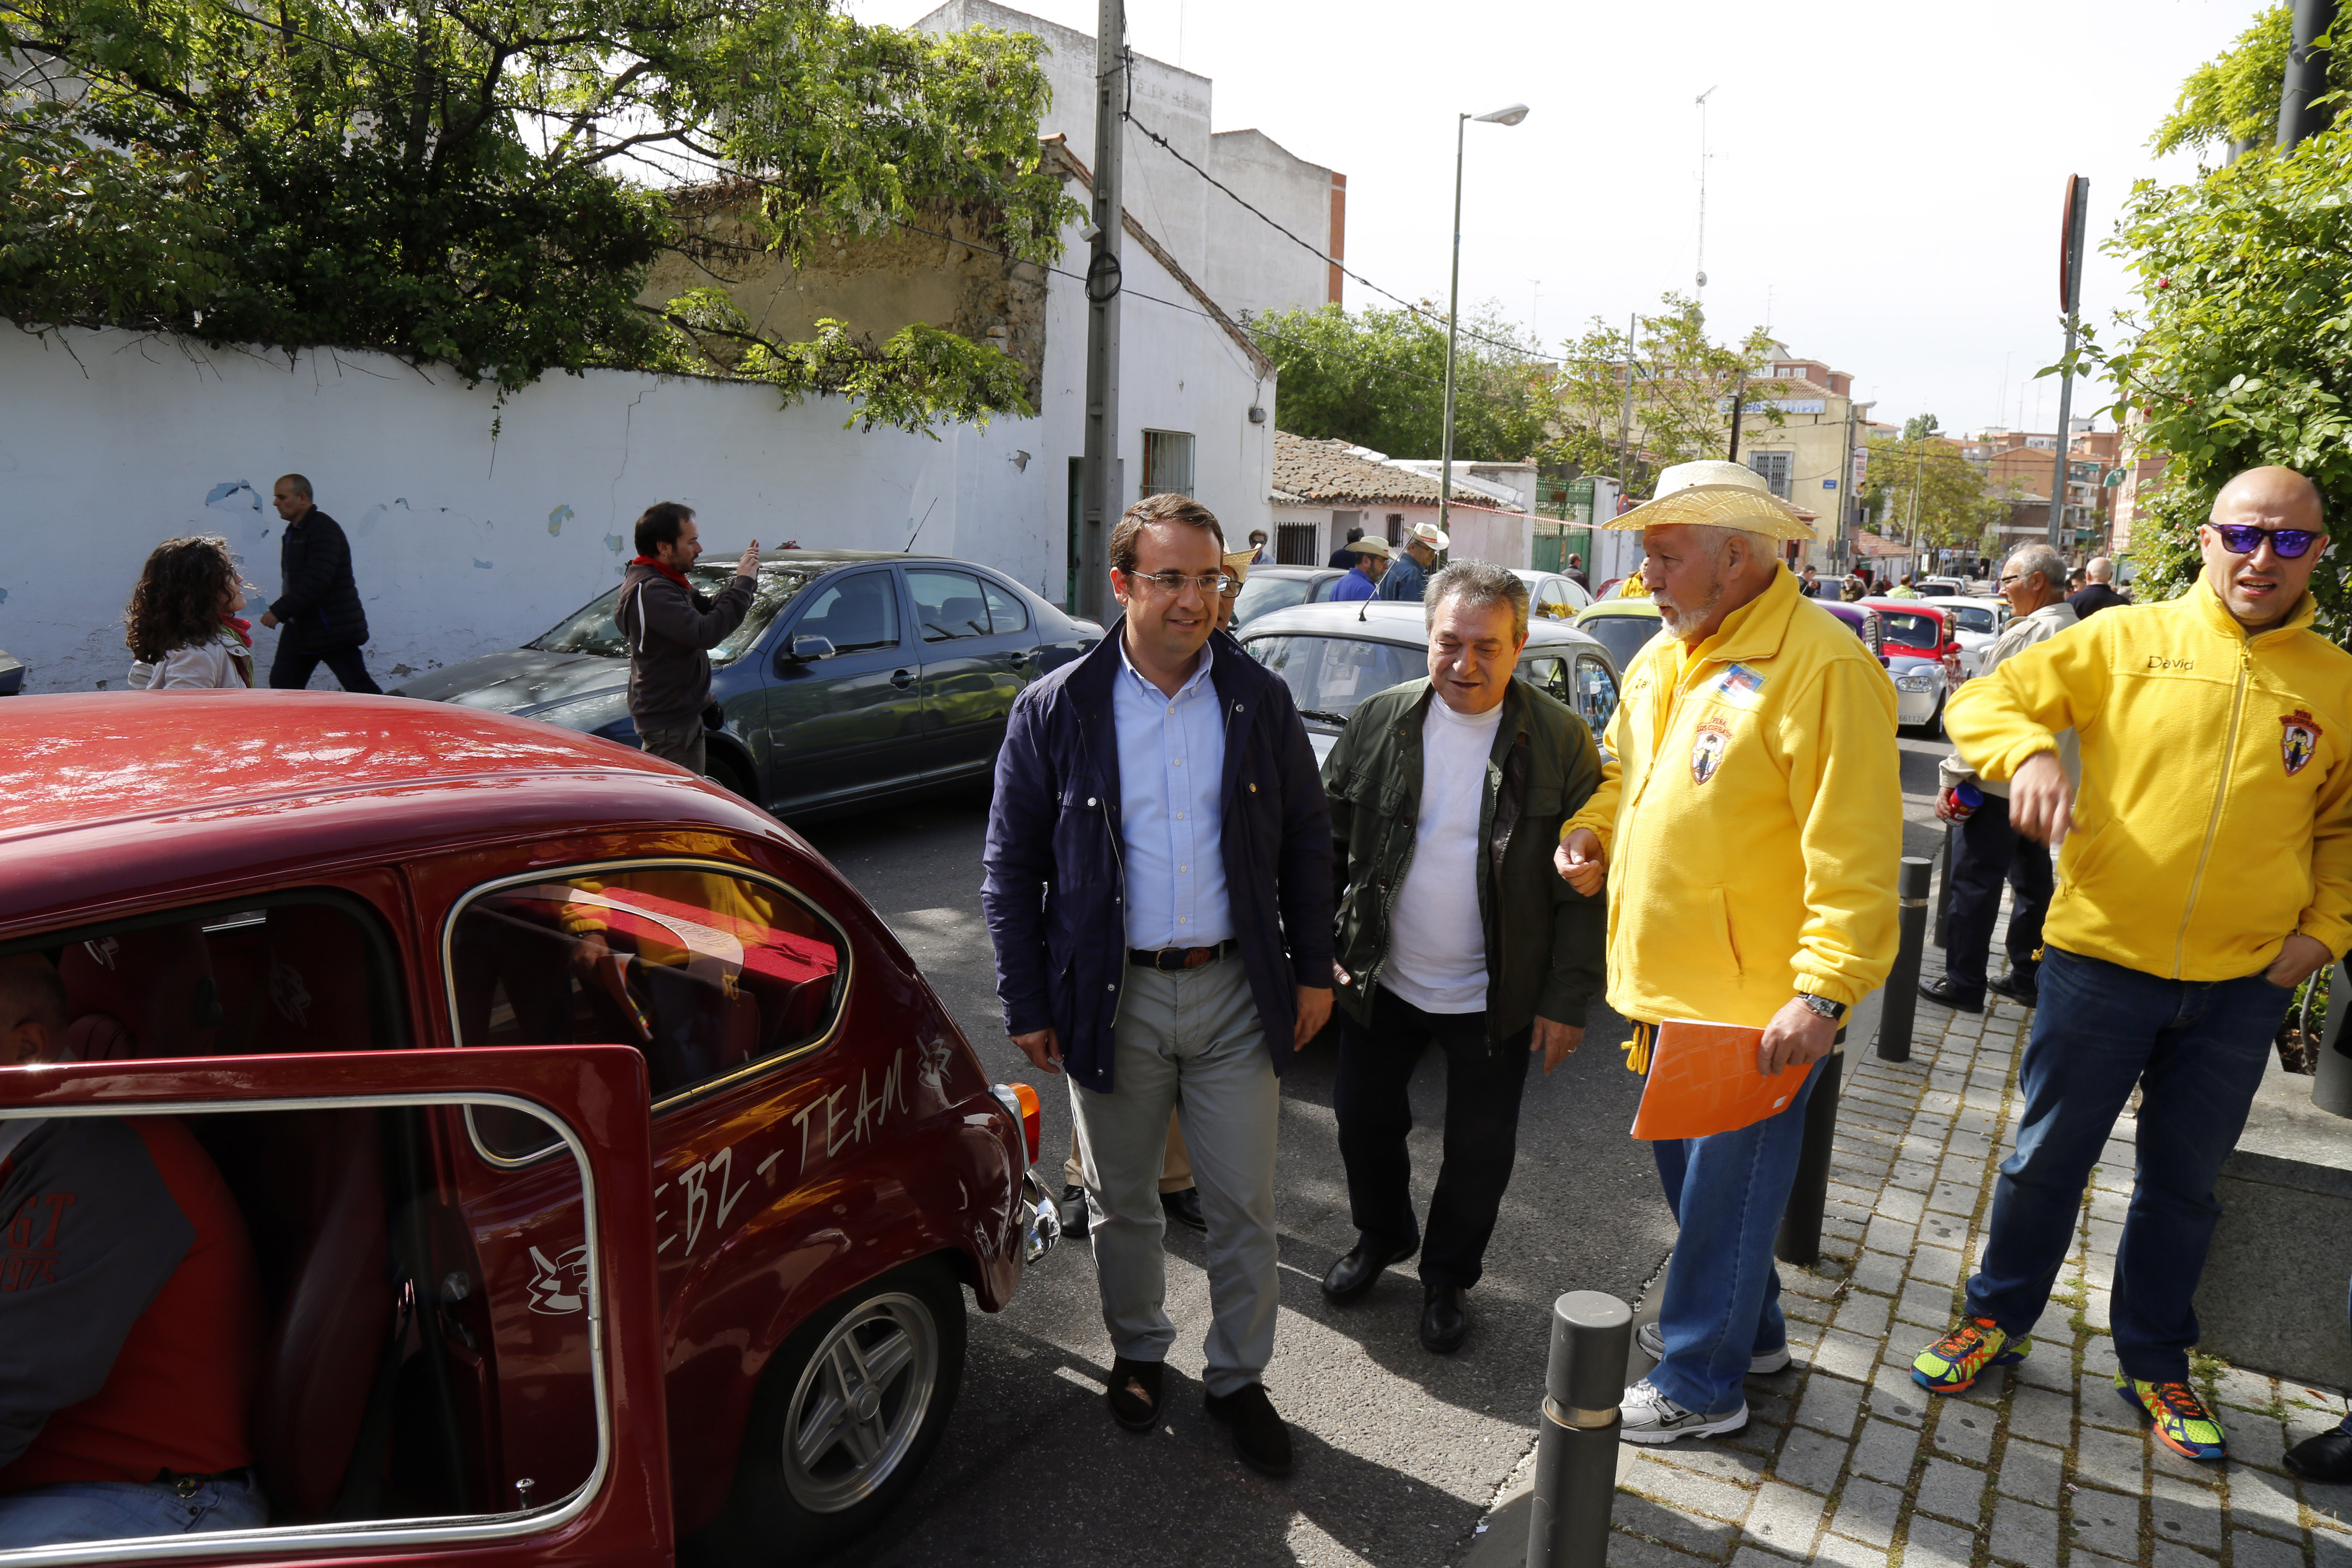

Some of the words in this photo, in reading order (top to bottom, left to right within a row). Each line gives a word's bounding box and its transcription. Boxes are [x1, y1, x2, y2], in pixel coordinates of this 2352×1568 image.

[2148, 656, 2194, 670] David
[792, 1048, 909, 1176] TEAM
[7, 1193, 77, 1250] GT
[0, 1257, 58, 1293] 1975
